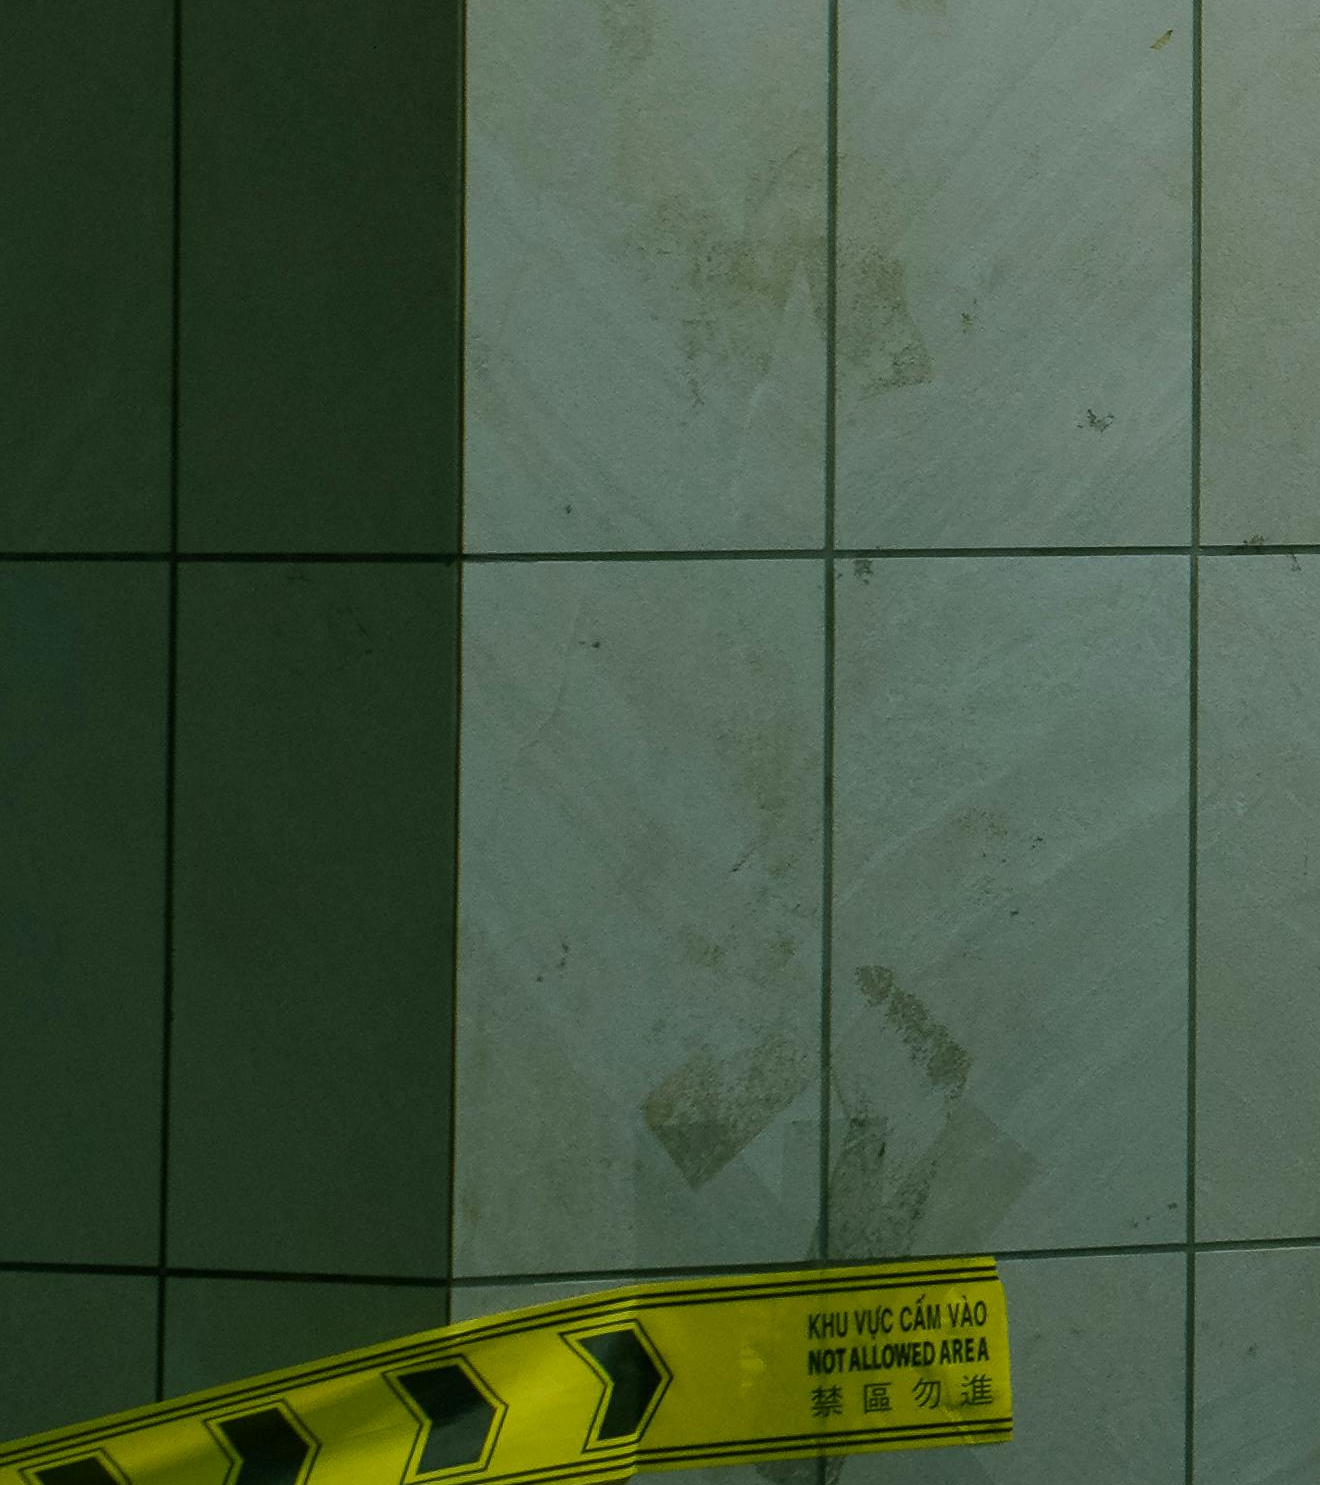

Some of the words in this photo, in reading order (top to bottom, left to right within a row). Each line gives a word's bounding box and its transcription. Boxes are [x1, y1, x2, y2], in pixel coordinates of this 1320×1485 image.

[808, 1309, 848, 1339] KHU
[854, 1305, 893, 1339] VỰC
[900, 1294, 941, 1332] CẤM
[948, 1295, 987, 1327] VÀO
[808, 1348, 847, 1375] NOT
[848, 1340, 935, 1373] ALLOWED
[939, 1337, 990, 1365] AREA
[810, 1373, 994, 1418] 禁區勿進
